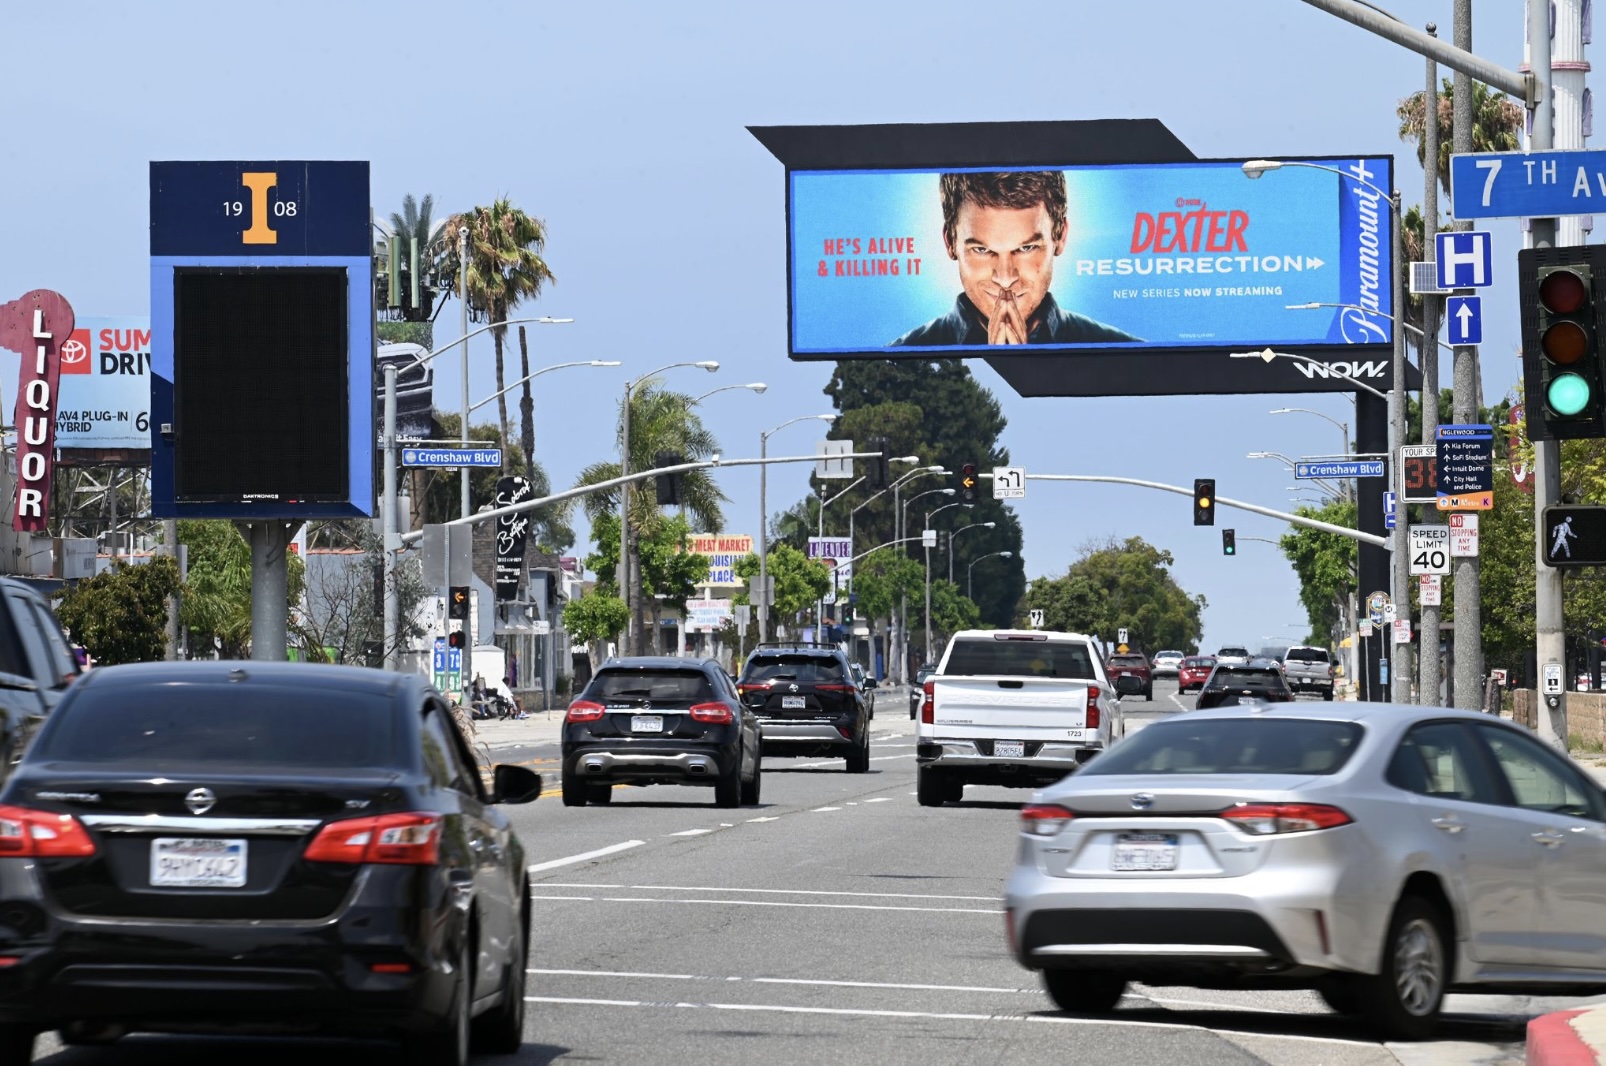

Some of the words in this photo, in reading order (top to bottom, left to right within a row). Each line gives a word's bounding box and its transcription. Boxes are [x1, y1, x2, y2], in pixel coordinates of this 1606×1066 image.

[1475, 159, 1502, 207] 7
[1522, 160, 1557, 185] TH
[223, 201, 243, 216] 19
[274, 201, 297, 217] 08
[1129, 202, 1250, 254] DEXTER
[823, 238, 861, 256] HE'S
[867, 237, 915, 255] ALIVE
[1076, 254, 1302, 276] RESURRECTION
[1443, 235, 1485, 285] H
[817, 260, 828, 277] &
[835, 259, 900, 276] KILLING
[906, 258, 922, 275] IT
[1113, 289, 1138, 299] NEW
[1142, 288, 1181, 298] SERIES
[1184, 287, 1212, 297] NOW
[1215, 286, 1283, 297] STREAMING
[18, 309, 52, 518] LIQUOR
[55, 411, 78, 422] AV4
[82, 410, 128, 422] PLUG-IN
[136, 411, 151, 433] 6
[418, 452, 472, 463] Crenshaw
[474, 451, 499, 463] Blvd
[1404, 449, 1423, 457] YOUR
[1310, 464, 1358, 475] Crenshaw
[1360, 463, 1381, 474] Blvd
[1483, 498, 1489, 506] K
[1451, 516, 1463, 527] NO
[1412, 530, 1448, 539] SPEED
[1451, 528, 1478, 537] STOPPING
[695, 538, 716, 552] MEAT
[718, 538, 751, 552] MARKET
[1416, 540, 1443, 549] LIMIT
[1412, 551, 1446, 569] 40
